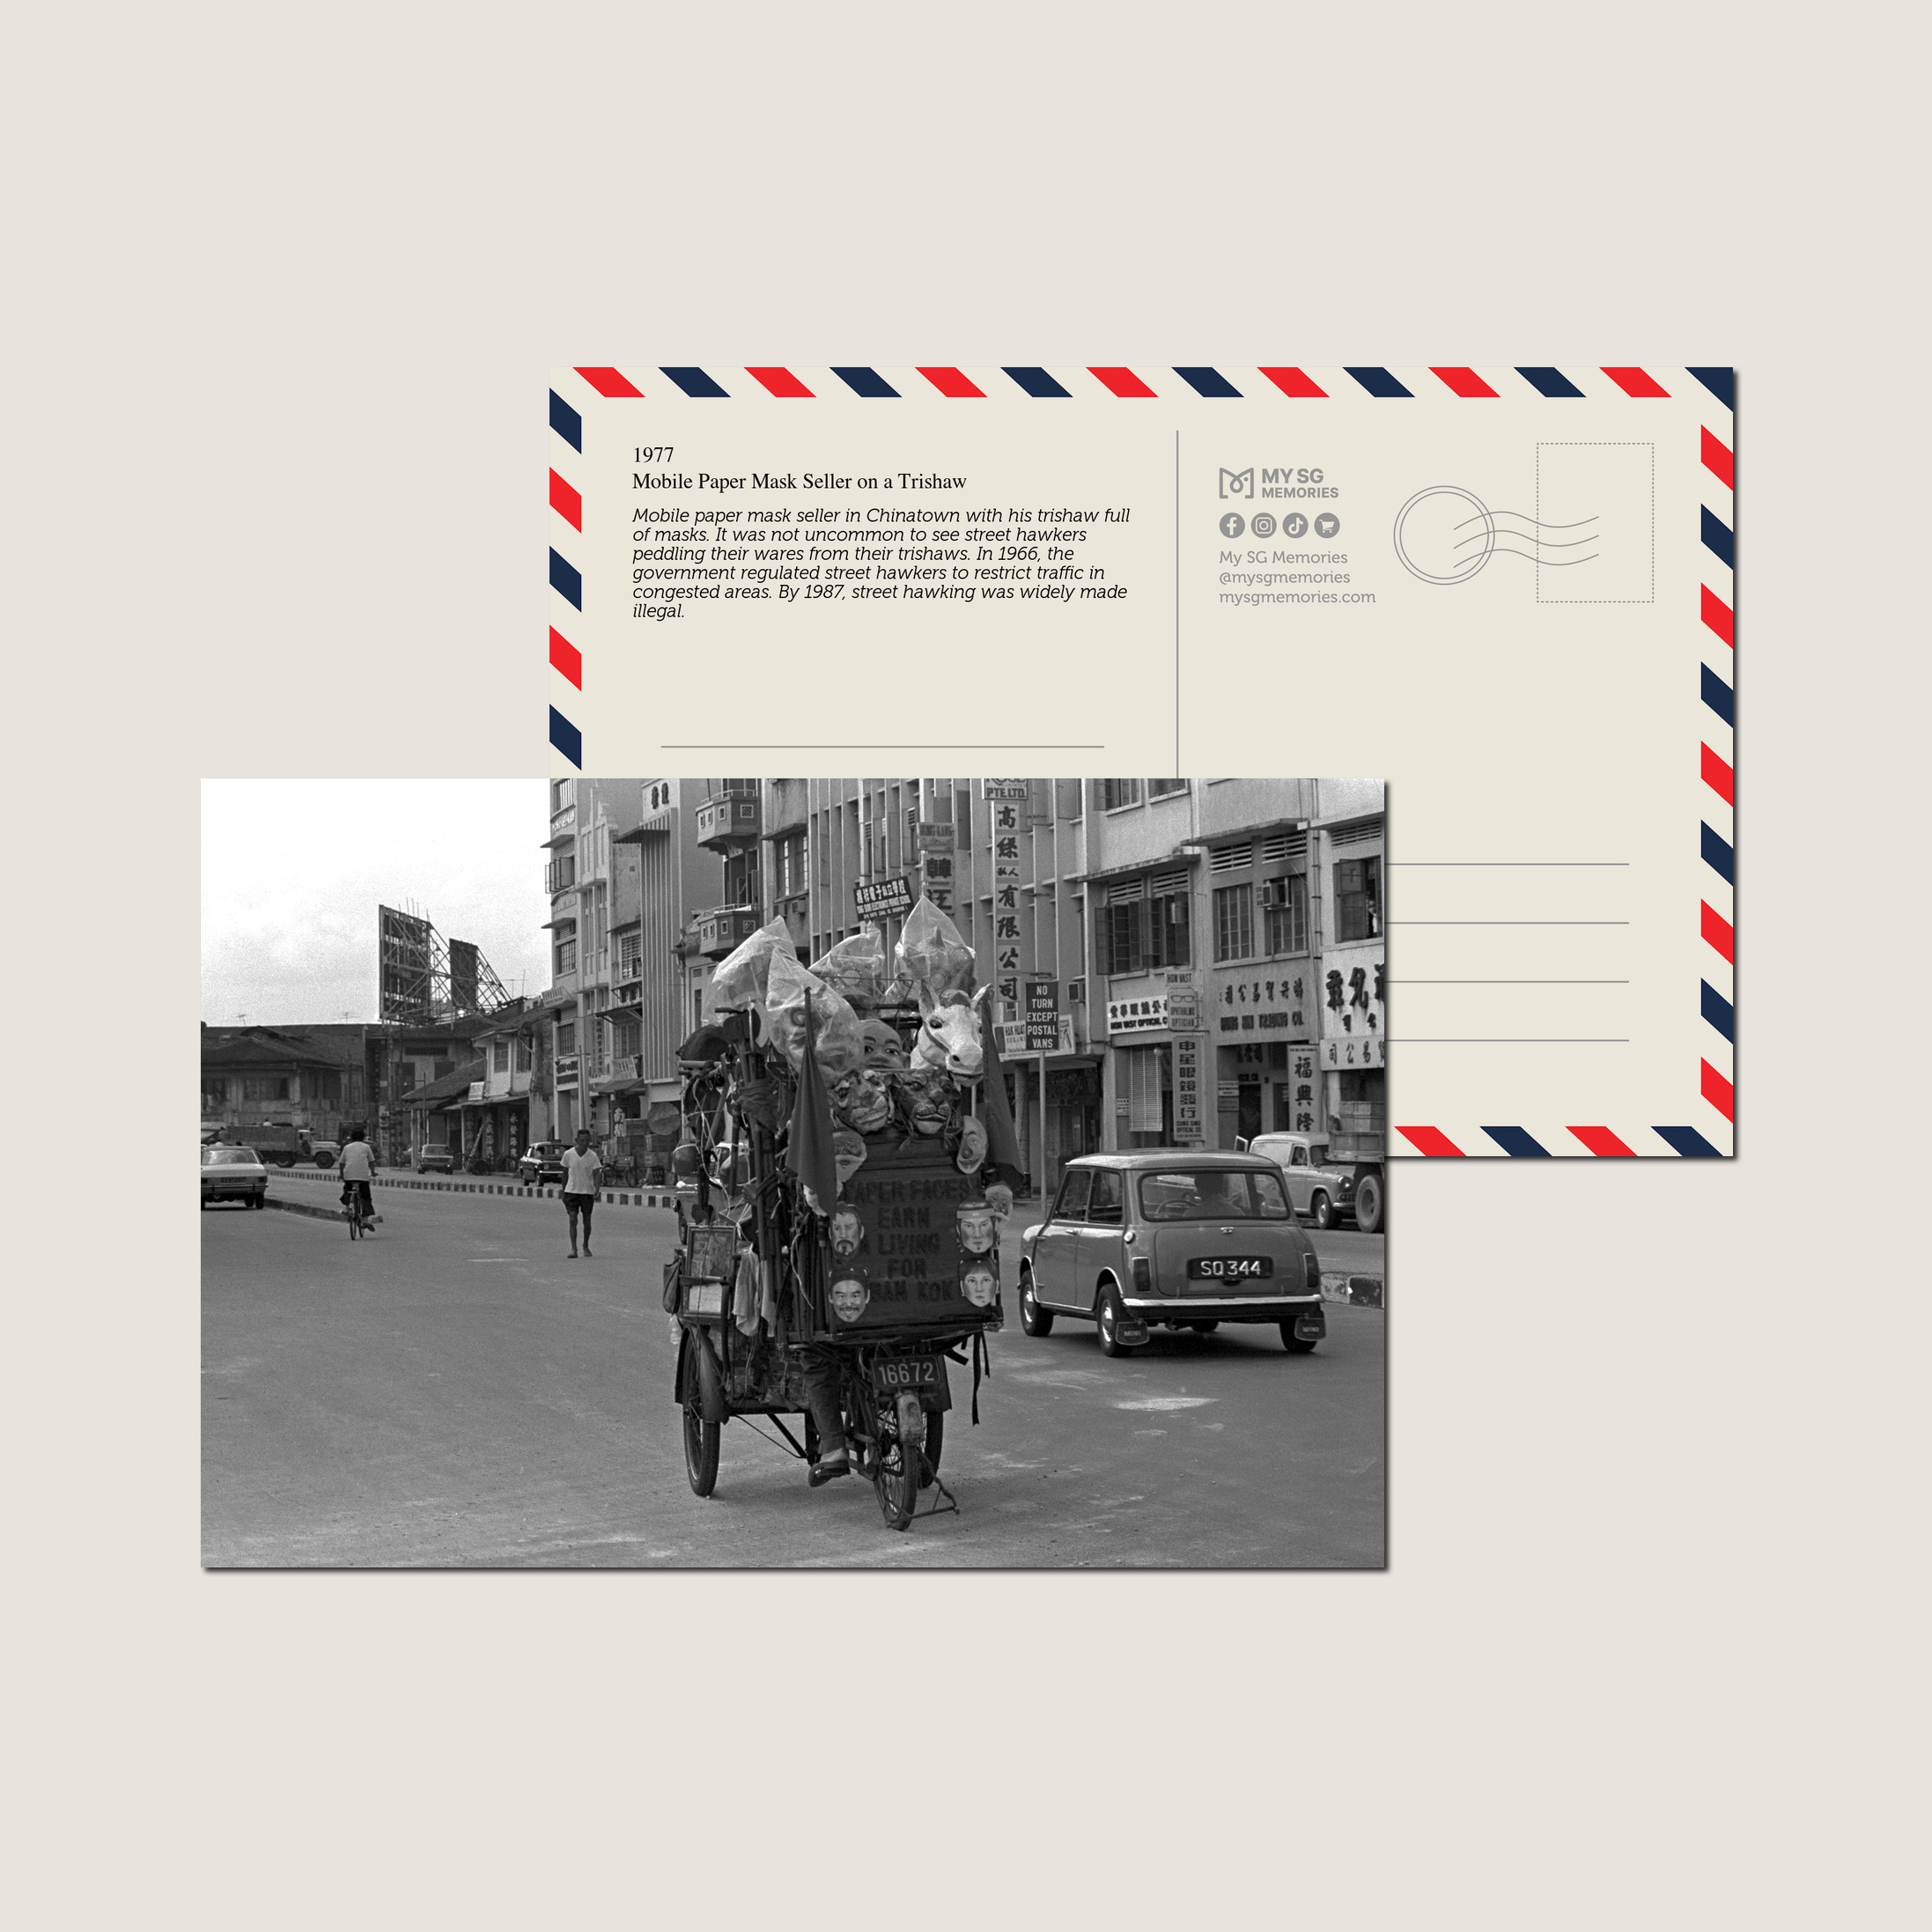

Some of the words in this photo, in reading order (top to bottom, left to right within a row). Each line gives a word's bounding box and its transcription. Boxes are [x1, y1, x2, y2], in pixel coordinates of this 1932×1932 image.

[633, 447, 674, 462] 1977
[632, 474, 692, 490] Mobile
[698, 474, 746, 493] Paper
[752, 474, 797, 490] Mask
[803, 474, 852, 490] Seller
[858, 478, 877, 490] on
[884, 478, 893, 490] a
[898, 474, 967, 490] Trishaw
[1262, 468, 1294, 483] MY
[1297, 468, 1324, 483] SG
[1262, 487, 1338, 498] MEMORIES
[632, 508, 689, 522] Mobile
[695, 512, 742, 526] paper
[748, 508, 792, 522] mask
[797, 508, 841, 522] seller
[846, 508, 860, 522] in
[867, 508, 959, 522] Chinatown
[966, 508, 1002, 522] with
[1008, 508, 1032, 522] his
[1038, 508, 1099, 522] trishaw
[1105, 508, 1130, 522] full
[633, 527, 651, 542] of
[655, 527, 710, 542] masks.
[716, 527, 728, 542] It
[733, 531, 765, 542] was
[771, 528, 800, 542] not
[806, 531, 903, 542] uncommon
[911, 528, 926, 542] to
[932, 531, 959, 542] see
[965, 528, 1011, 542] street
[1016, 527, 1087, 542] hawkers
[633, 547, 706, 564] peddling
[712, 547, 749, 560] their
[755, 549, 804, 560] wares
[809, 547, 848, 560] from
[856, 547, 893, 560] their
[899, 547, 970, 560] trishaws.
[977, 547, 992, 560] In
[999, 547, 1041, 563] 1966,
[1048, 547, 1073, 560] the
[1220, 550, 1243, 566] My
[1247, 550, 1268, 564] SG
[1272, 550, 1348, 564] Memories
[633, 566, 735, 583] government
[741, 565, 820, 583] regulated
[825, 566, 871, 579] street
[876, 565, 947, 579] hawkers
[953, 566, 969, 579] to
[975, 565, 1031, 579] restrict
[1037, 565, 1084, 579] traffic
[1090, 565, 1104, 579] in
[1220, 571, 1351, 586] @mysgmemories
[633, 585, 720, 602] congested
[725, 588, 772, 599] areas.
[779, 585, 800, 602] By
[804, 585, 845, 601] 1987,
[852, 586, 898, 599] street
[903, 585, 977, 602] hawking
[981, 588, 1014, 599] was
[1021, 585, 1075, 602] widely
[1080, 585, 1127, 599] made
[1220, 591, 1376, 606] mysgmemories.com
[632, 604, 684, 621] illegal.
[1036, 985, 1048, 996] NO
[1031, 999, 1053, 1008] TURN
[1027, 1012, 1058, 1022] EXCEPT
[1257, 1012, 1288, 1029] TRADING
[1027, 1025, 1058, 1035] POSTAL
[1032, 1038, 1053, 1049] VANS
[845, 1180, 905, 1204] PAPER
[911, 1179, 970, 1201] FACES
[878, 1206, 930, 1229] EARN
[877, 1233, 940, 1255] LIVING
[887, 1258, 927, 1279] FOR
[1200, 1260, 1224, 1276] SQ
[1227, 1260, 1261, 1276] 344
[918, 1279, 954, 1302] KOK
[878, 1361, 935, 1385] 16672
